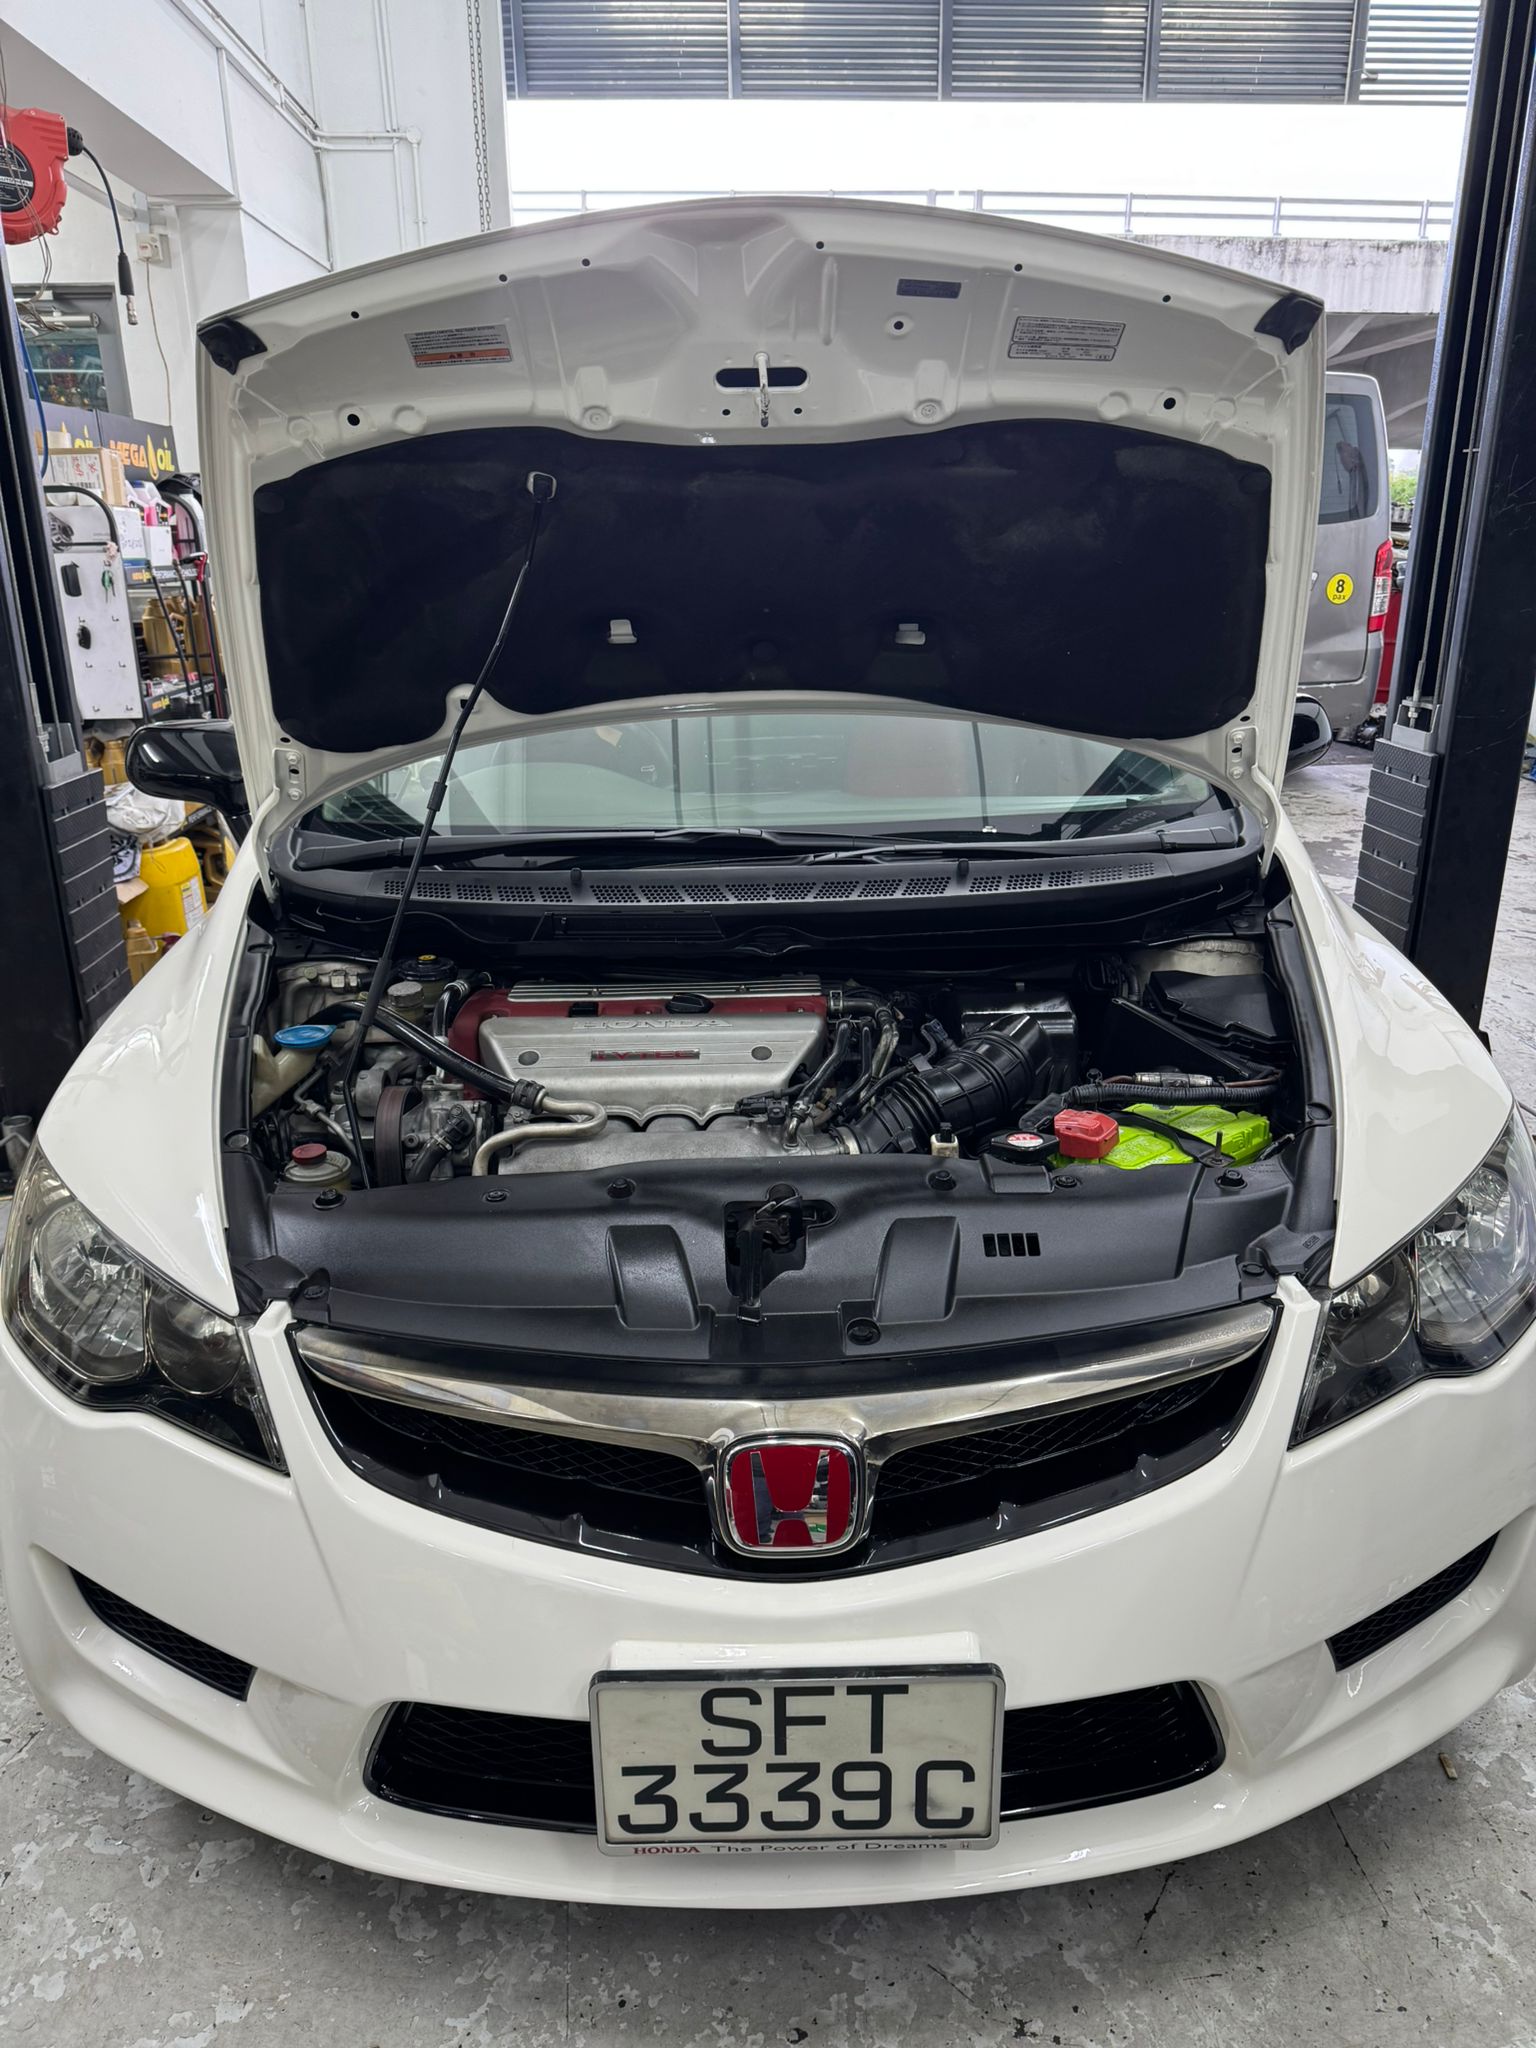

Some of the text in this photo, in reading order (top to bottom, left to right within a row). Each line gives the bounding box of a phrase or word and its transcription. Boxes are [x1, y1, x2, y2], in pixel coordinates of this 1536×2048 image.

[1336, 579, 1345, 593] 8
[572, 1018, 733, 1031] HONDA
[700, 1684, 909, 1757] SFT
[633, 1842, 948, 1855] HONDA The Power of Dreams
